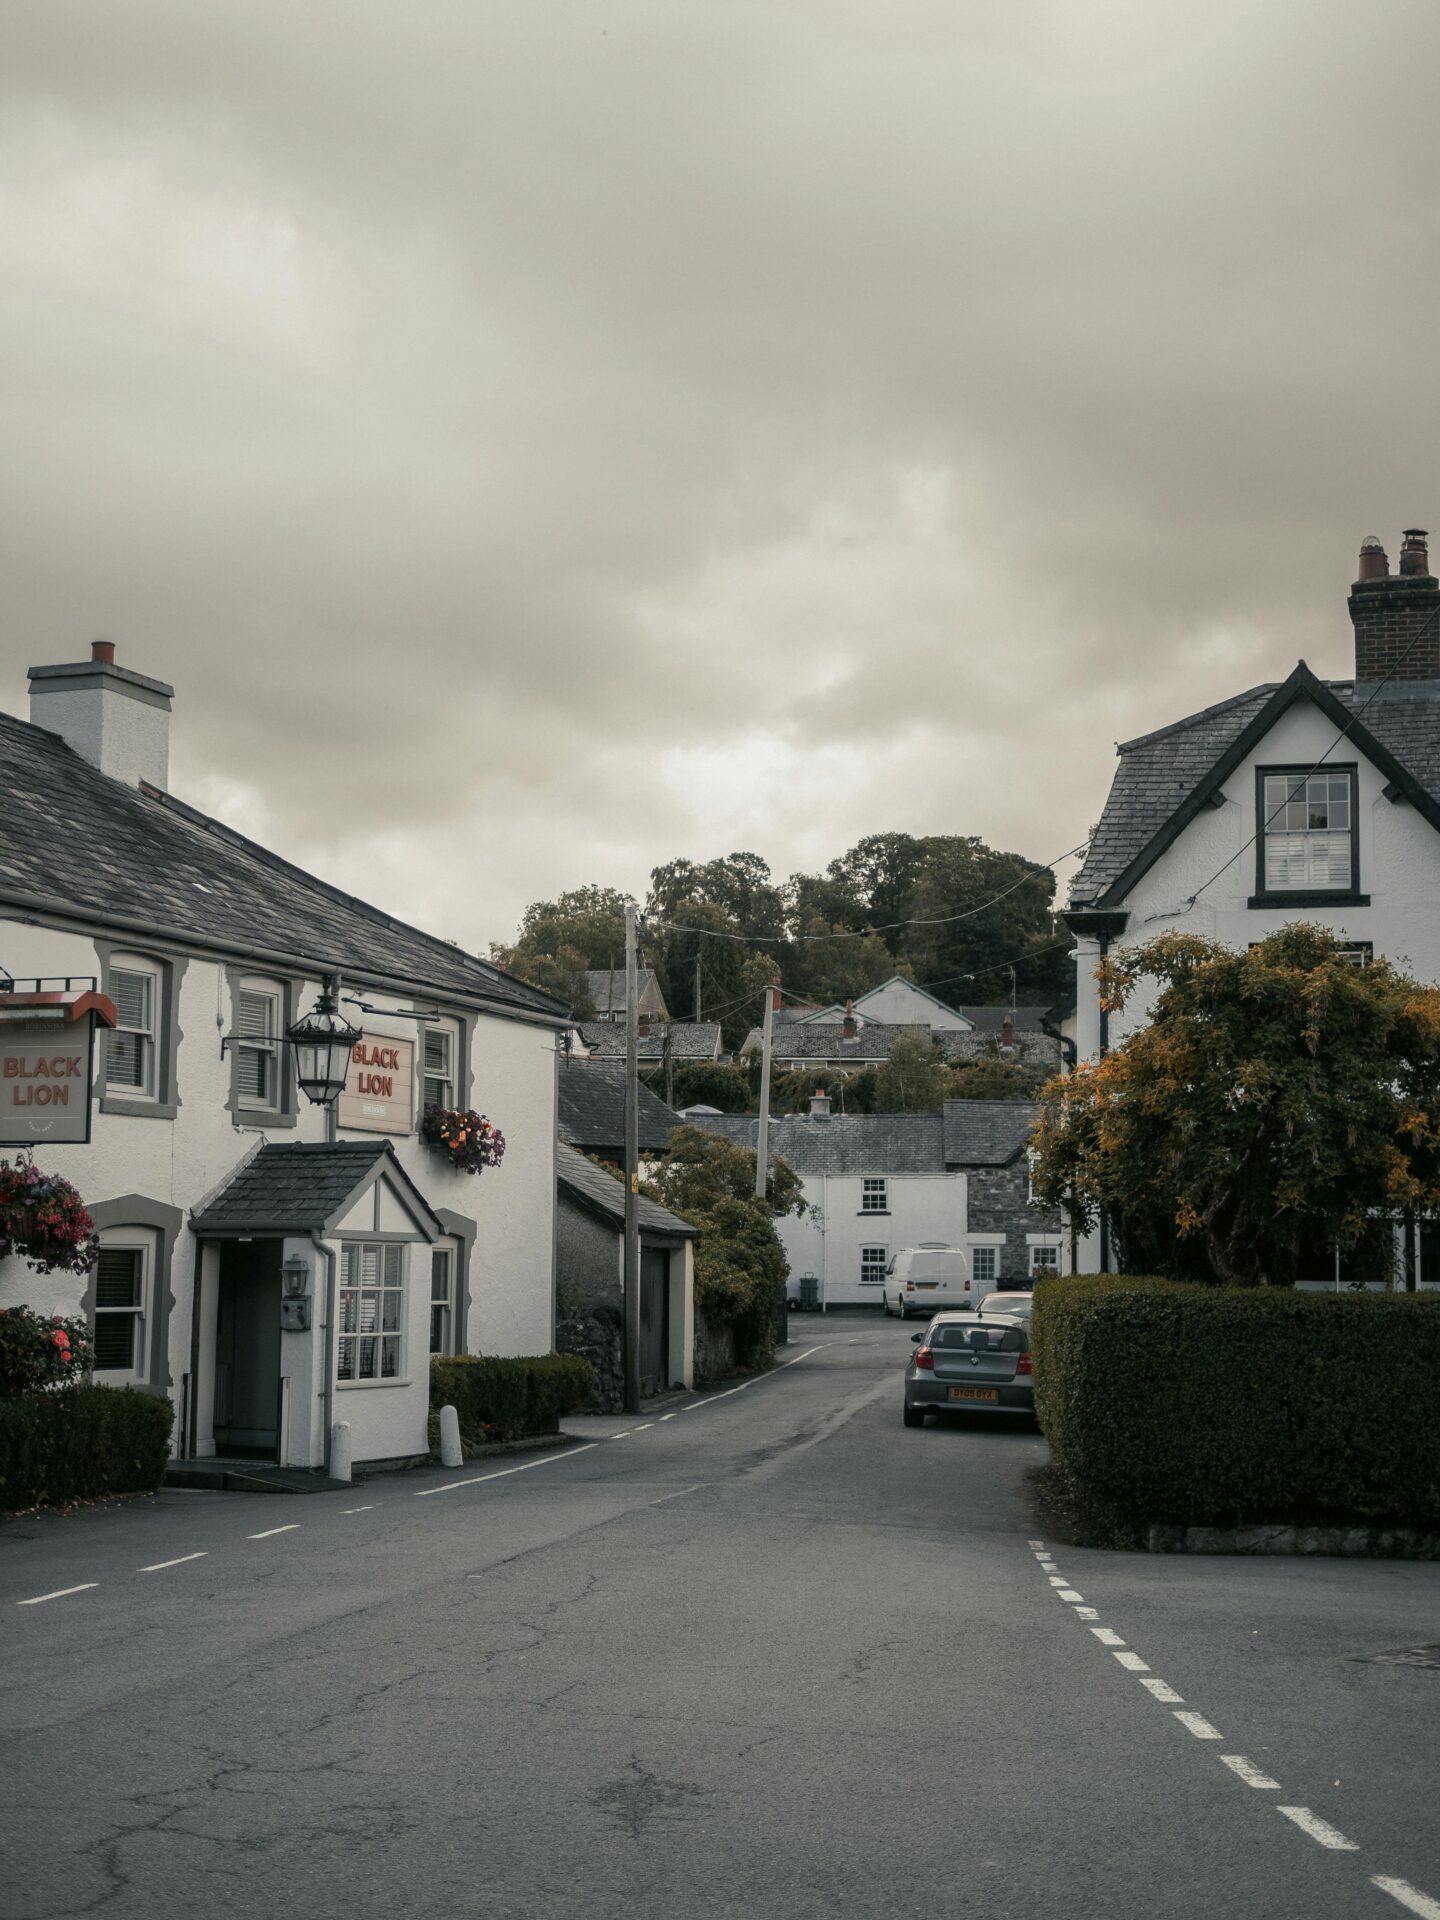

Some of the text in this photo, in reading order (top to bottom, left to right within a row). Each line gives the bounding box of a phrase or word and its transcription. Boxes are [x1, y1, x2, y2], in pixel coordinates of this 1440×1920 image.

[3, 1056, 82, 1078] BLACK
[352, 1043, 400, 1070] BLACK
[13, 1085, 69, 1106] LION
[358, 1072, 393, 1097] LION
